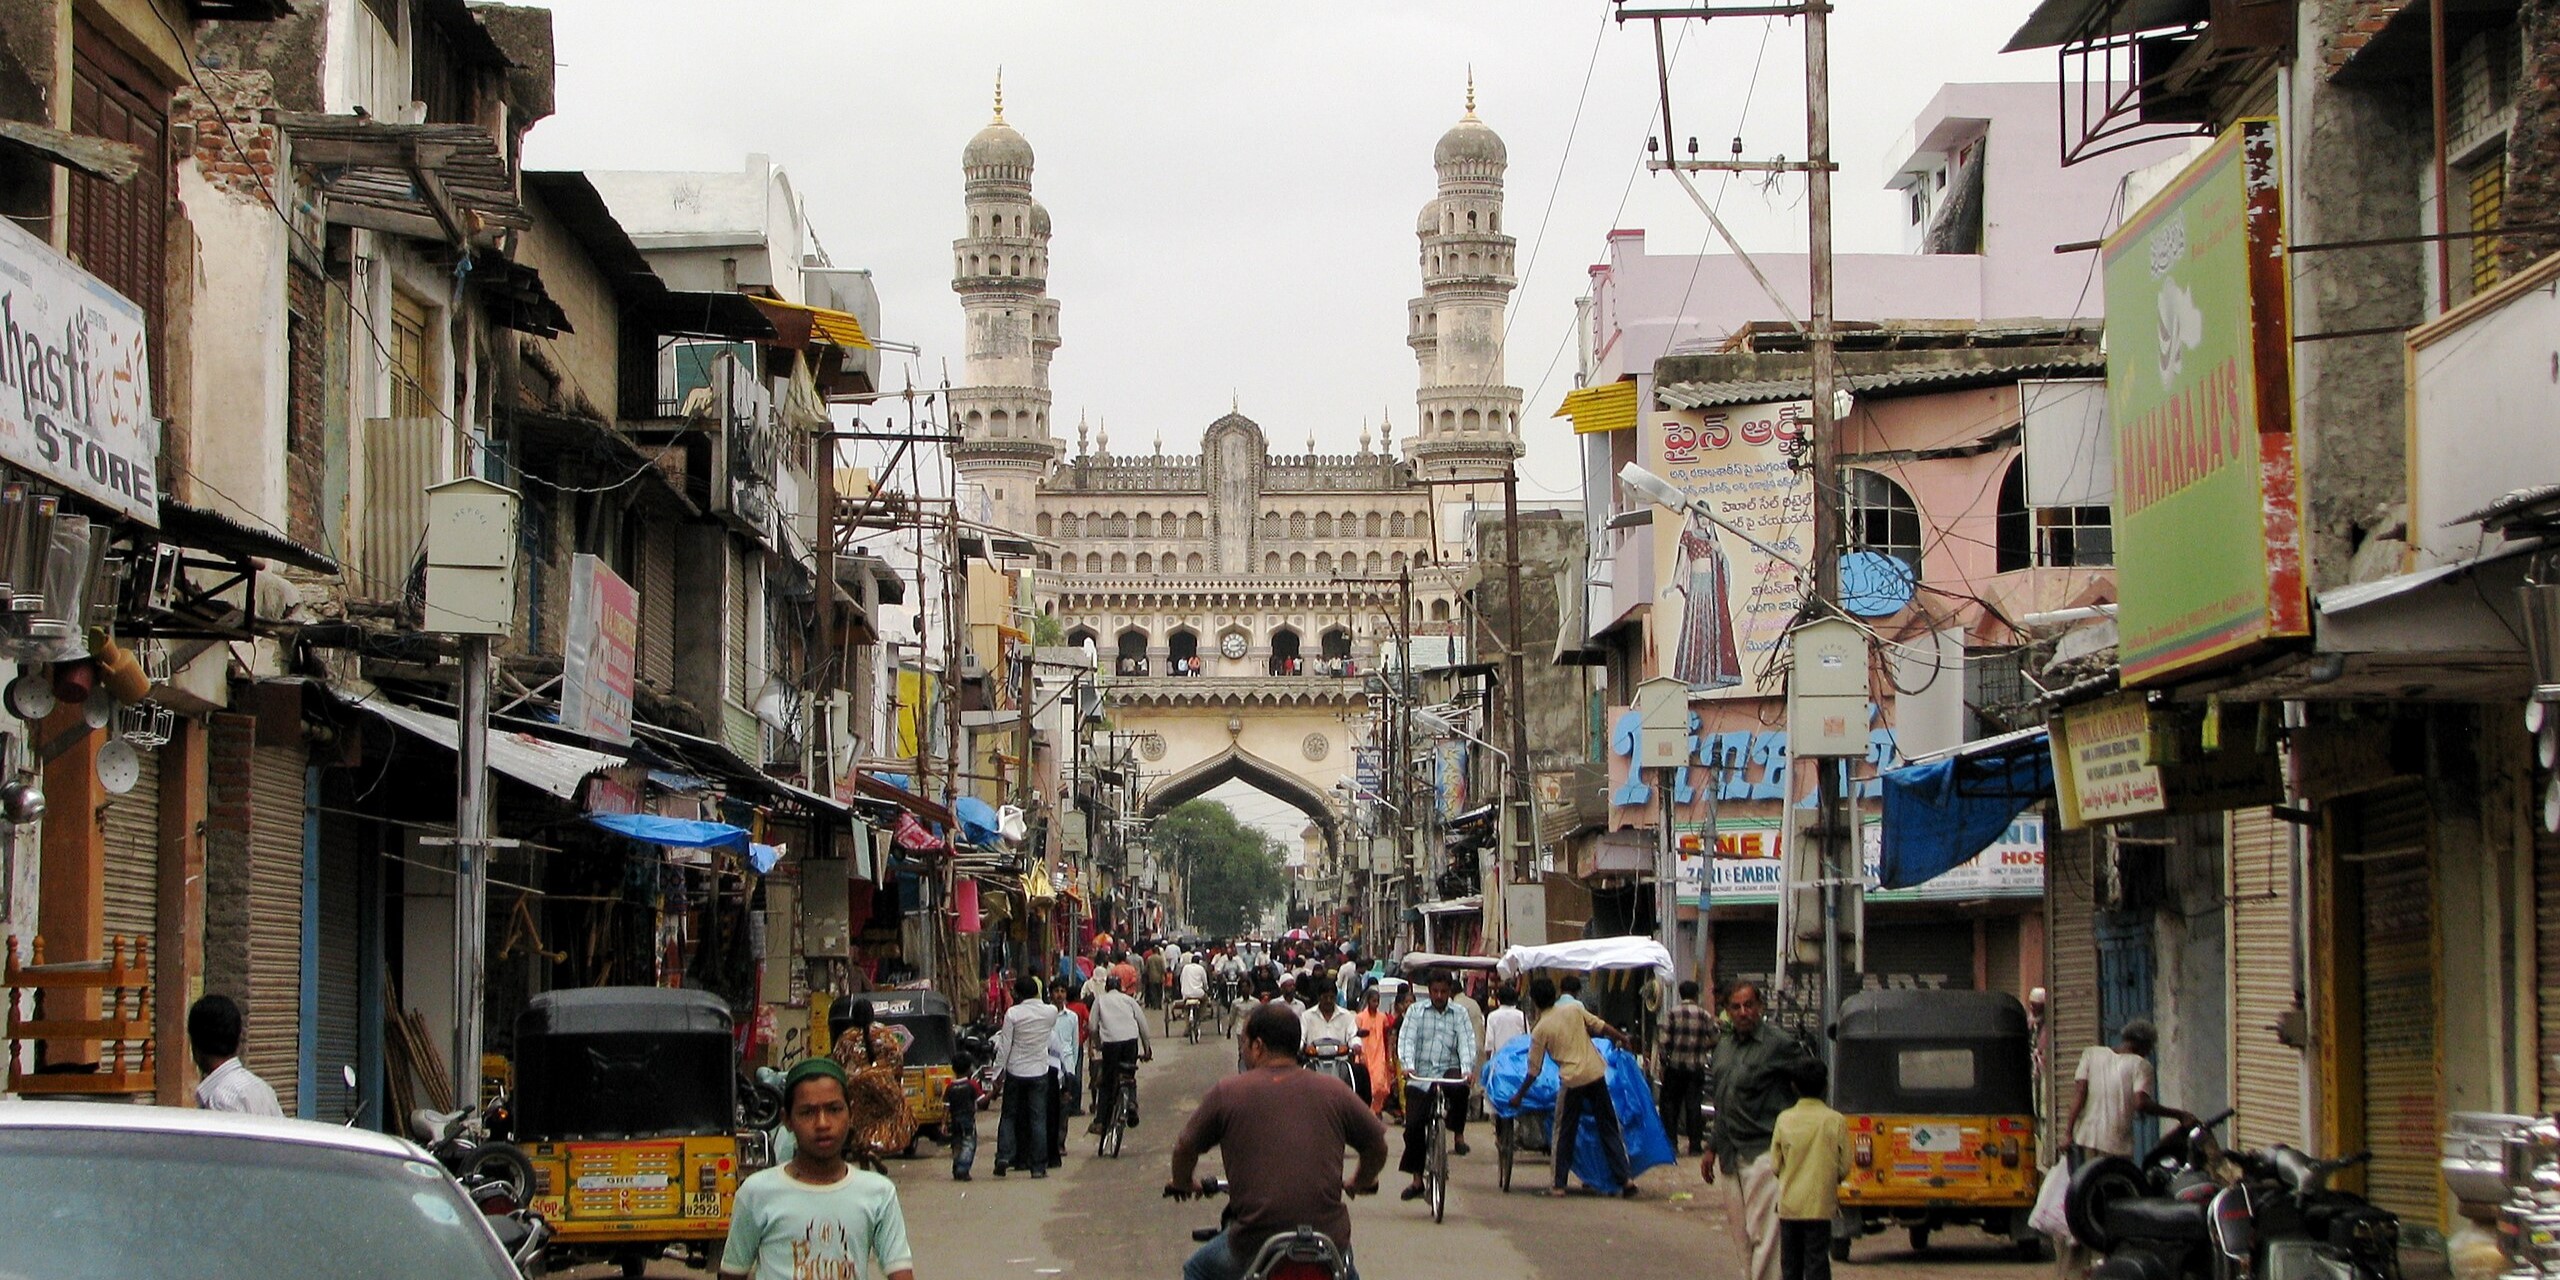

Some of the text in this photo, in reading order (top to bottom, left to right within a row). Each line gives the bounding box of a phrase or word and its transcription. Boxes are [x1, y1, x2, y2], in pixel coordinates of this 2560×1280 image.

[0, 290, 92, 427] hasti
[34, 413, 153, 508] STORE
[1662, 412, 1732, 463] ఫైన్
[2121, 354, 2241, 517] MAHARAJA'S
[1679, 832, 1763, 862] FNE
[2001, 851, 2045, 865] HOS
[1734, 864, 1781, 884] EMBRO
